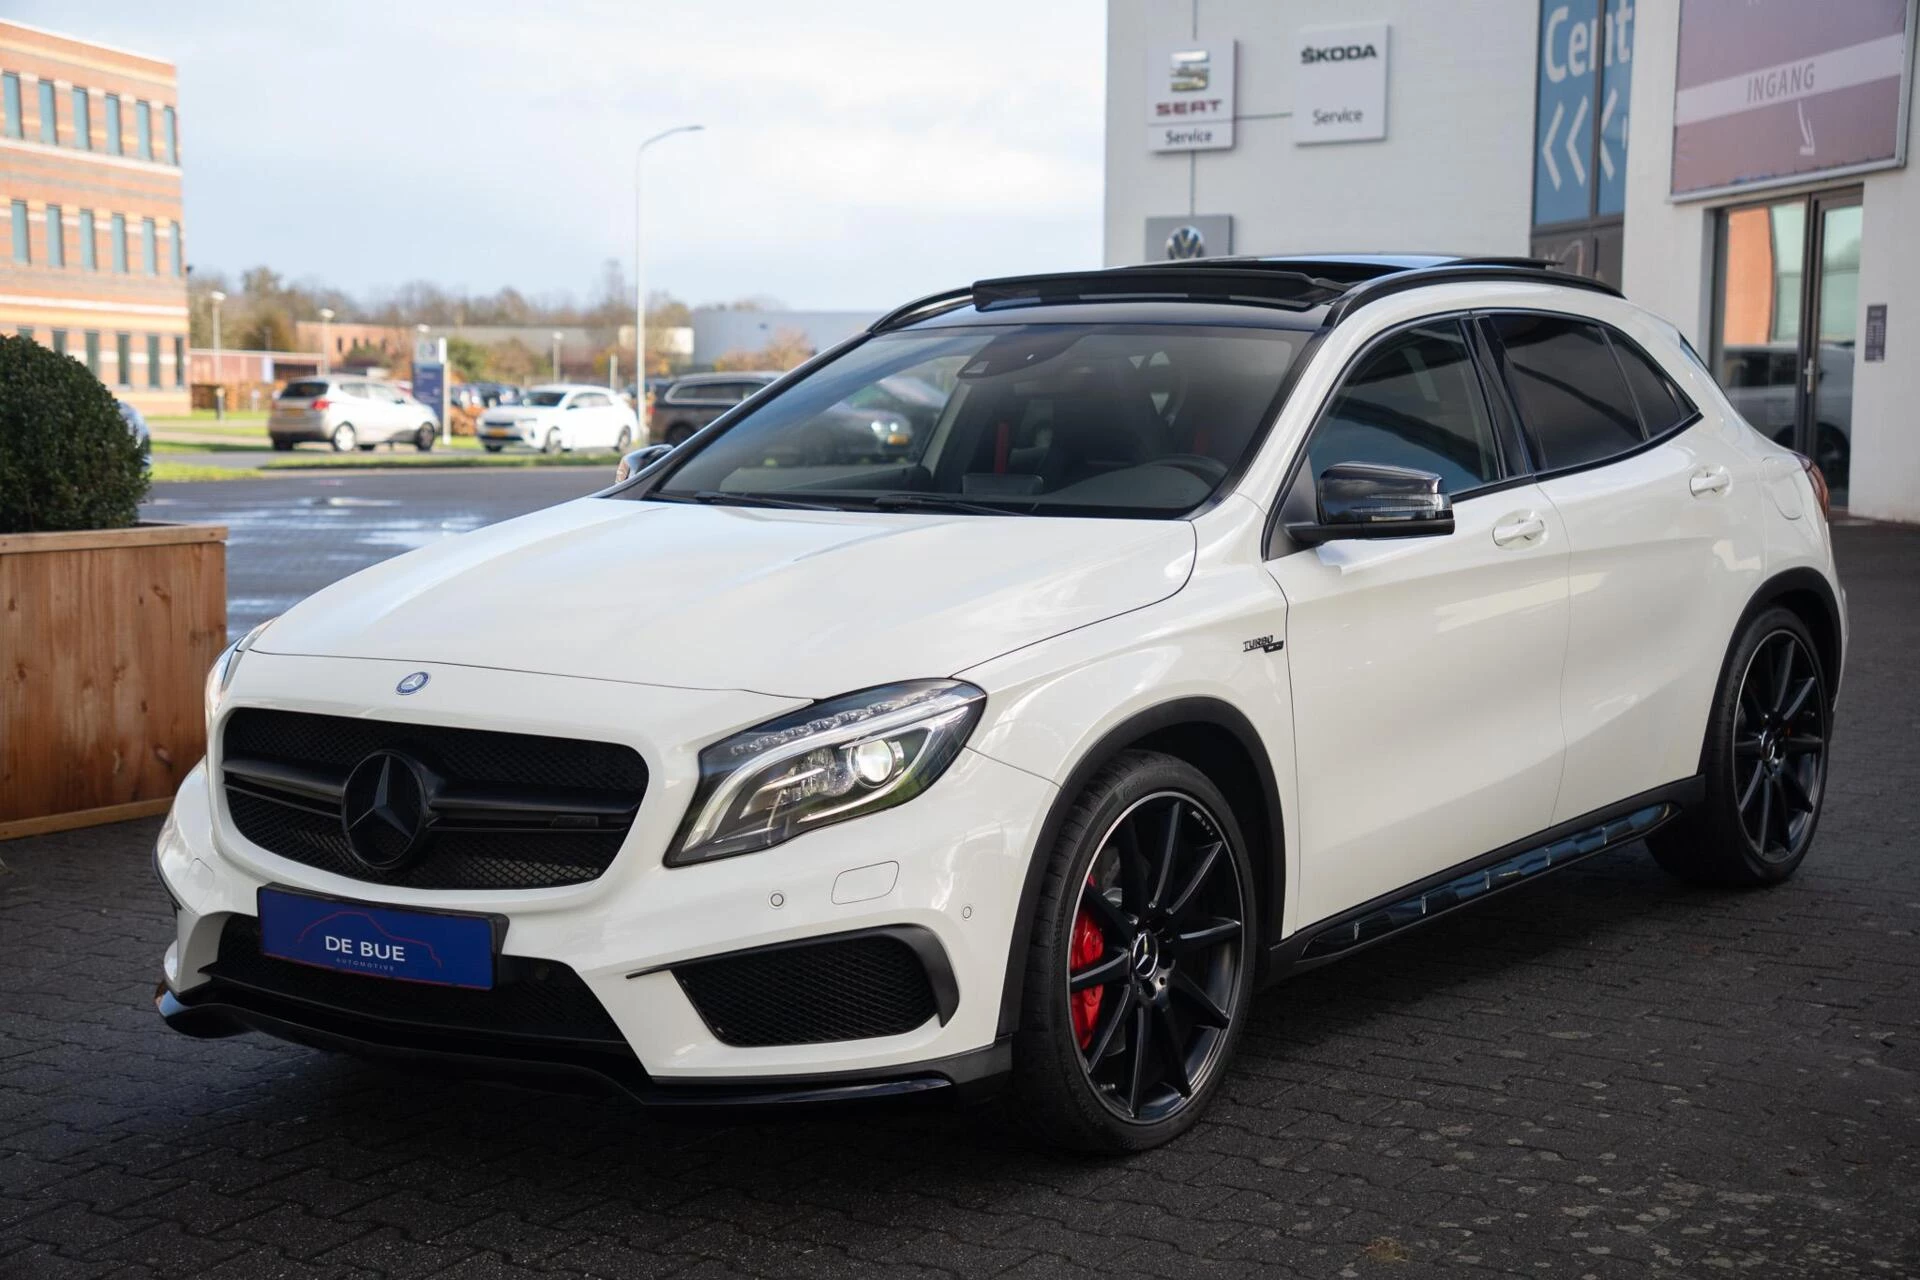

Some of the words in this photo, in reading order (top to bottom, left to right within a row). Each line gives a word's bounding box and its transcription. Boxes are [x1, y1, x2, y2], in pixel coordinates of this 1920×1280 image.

[1301, 44, 1378, 65] ŠKODA
[1747, 62, 1816, 103] INGANG
[1155, 99, 1223, 117] SEAT
[1313, 107, 1364, 126] Service
[1165, 130, 1213, 145] Service
[1243, 635, 1273, 652] TURBO
[325, 935, 353, 954] DE
[360, 941, 405, 962] BUE
[336, 957, 395, 972] AUTOMOTIVE
